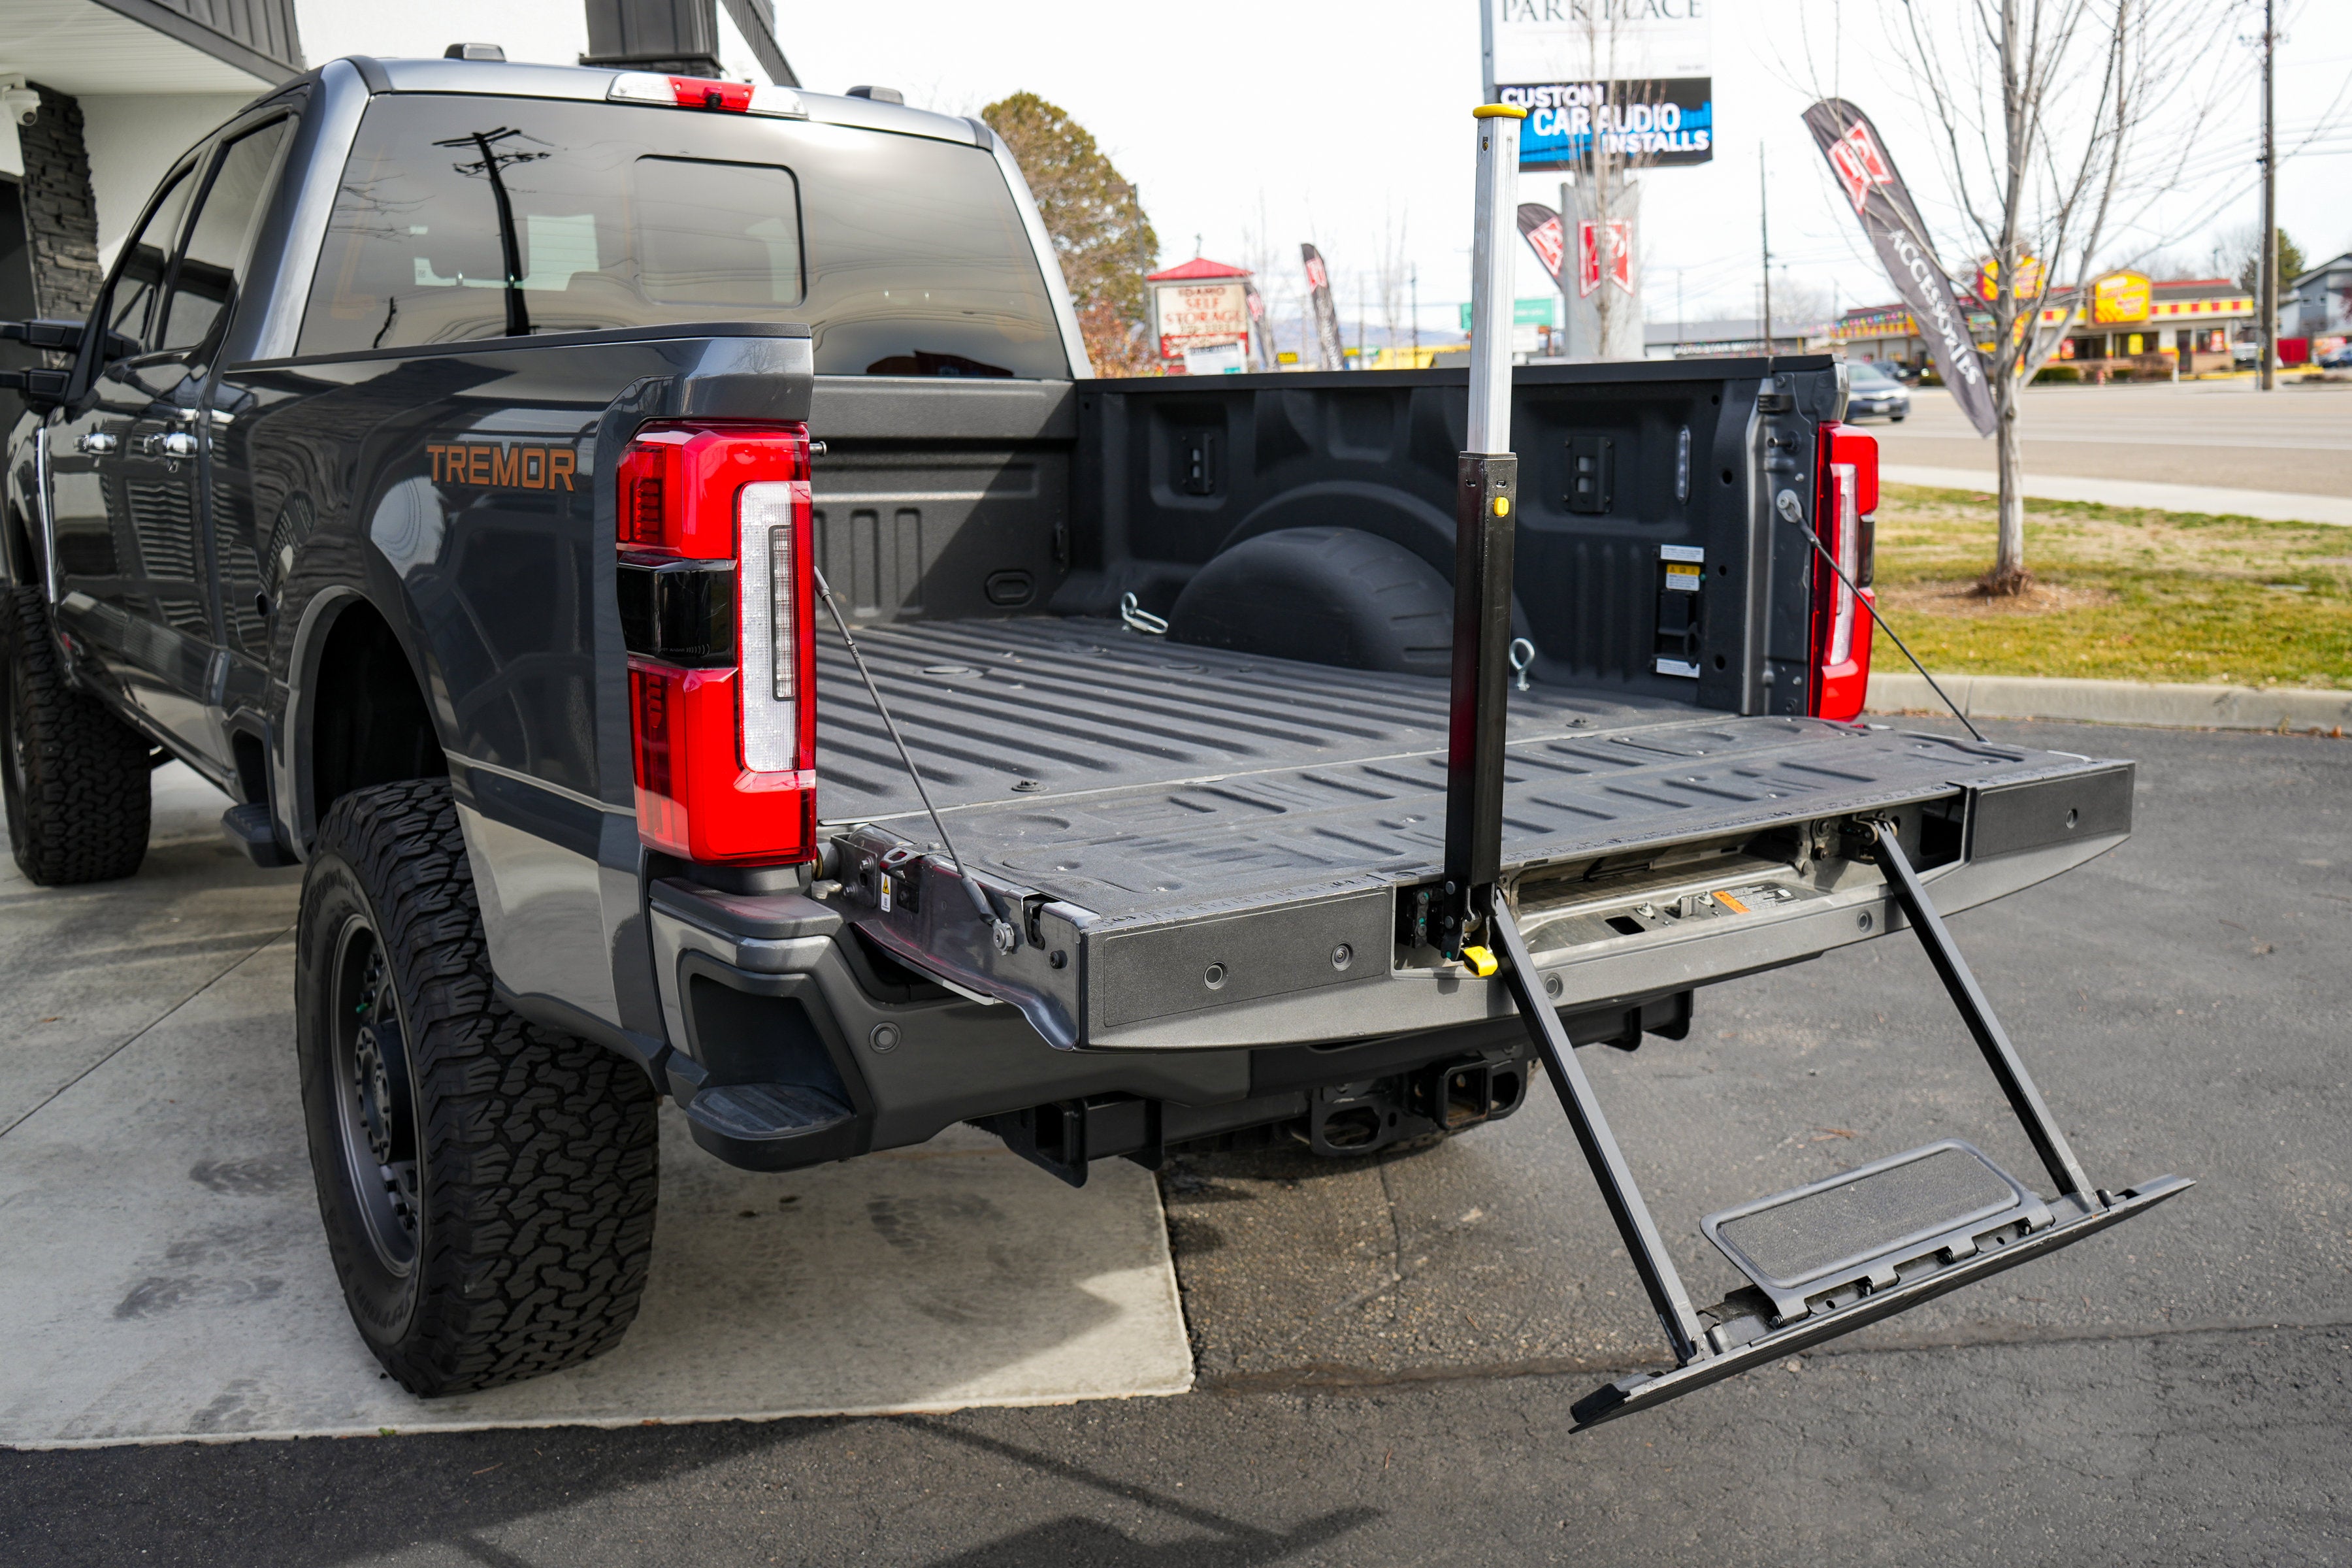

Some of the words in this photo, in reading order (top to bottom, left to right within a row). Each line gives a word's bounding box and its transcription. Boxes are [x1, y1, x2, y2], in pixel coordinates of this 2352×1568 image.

[1501, 84, 1604, 108] CUSTOM
[1533, 106, 1591, 136] CAR
[1597, 103, 1681, 133] AUDIO
[1601, 129, 1710, 154] INSTALLS
[427, 444, 574, 491] TREMOR
